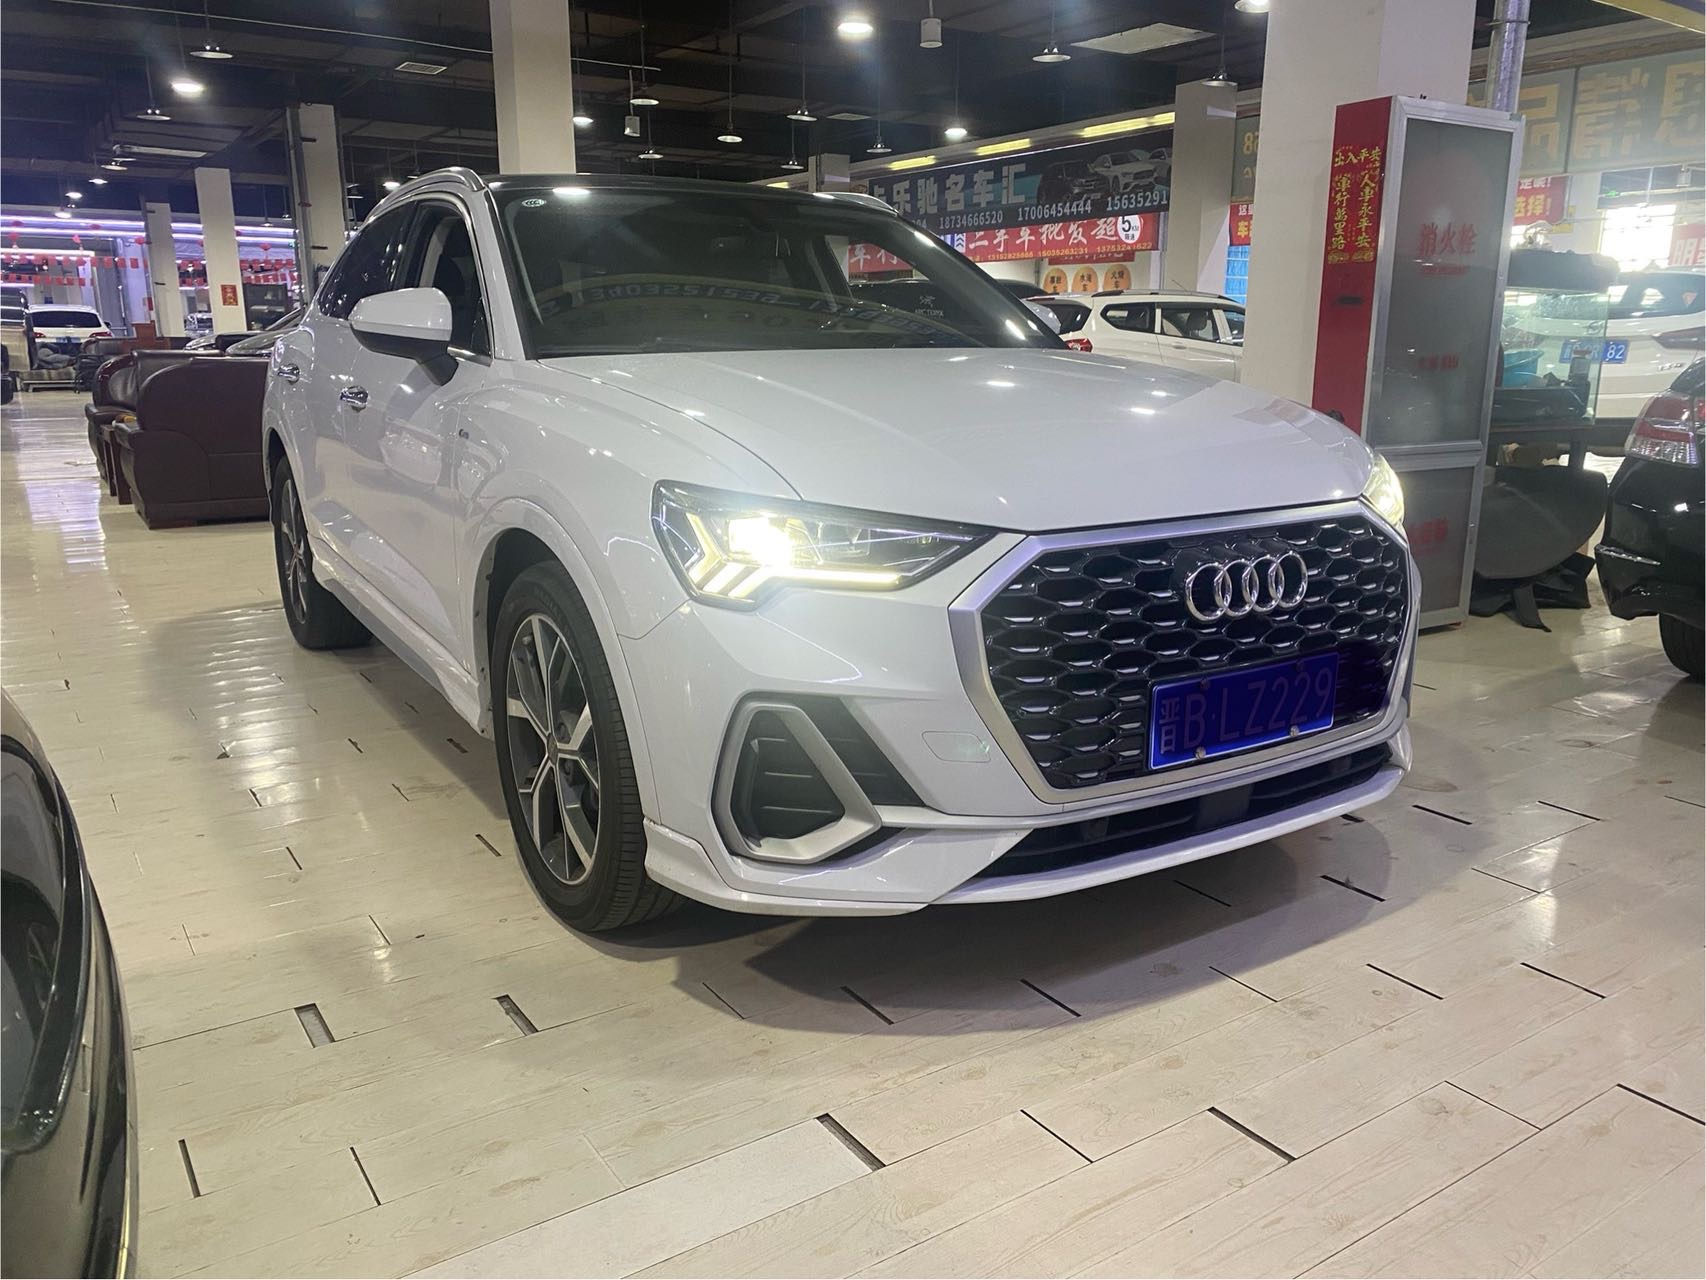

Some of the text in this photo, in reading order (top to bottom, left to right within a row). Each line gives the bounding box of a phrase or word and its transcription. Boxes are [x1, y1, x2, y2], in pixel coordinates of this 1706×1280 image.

[1333, 146, 1381, 167] 出入平安
[939, 212, 1003, 230] 18734666520
[1017, 200, 1092, 222] 17006454444
[1121, 215, 1131, 233] 5
[968, 215, 1144, 253] 二手车批发超
